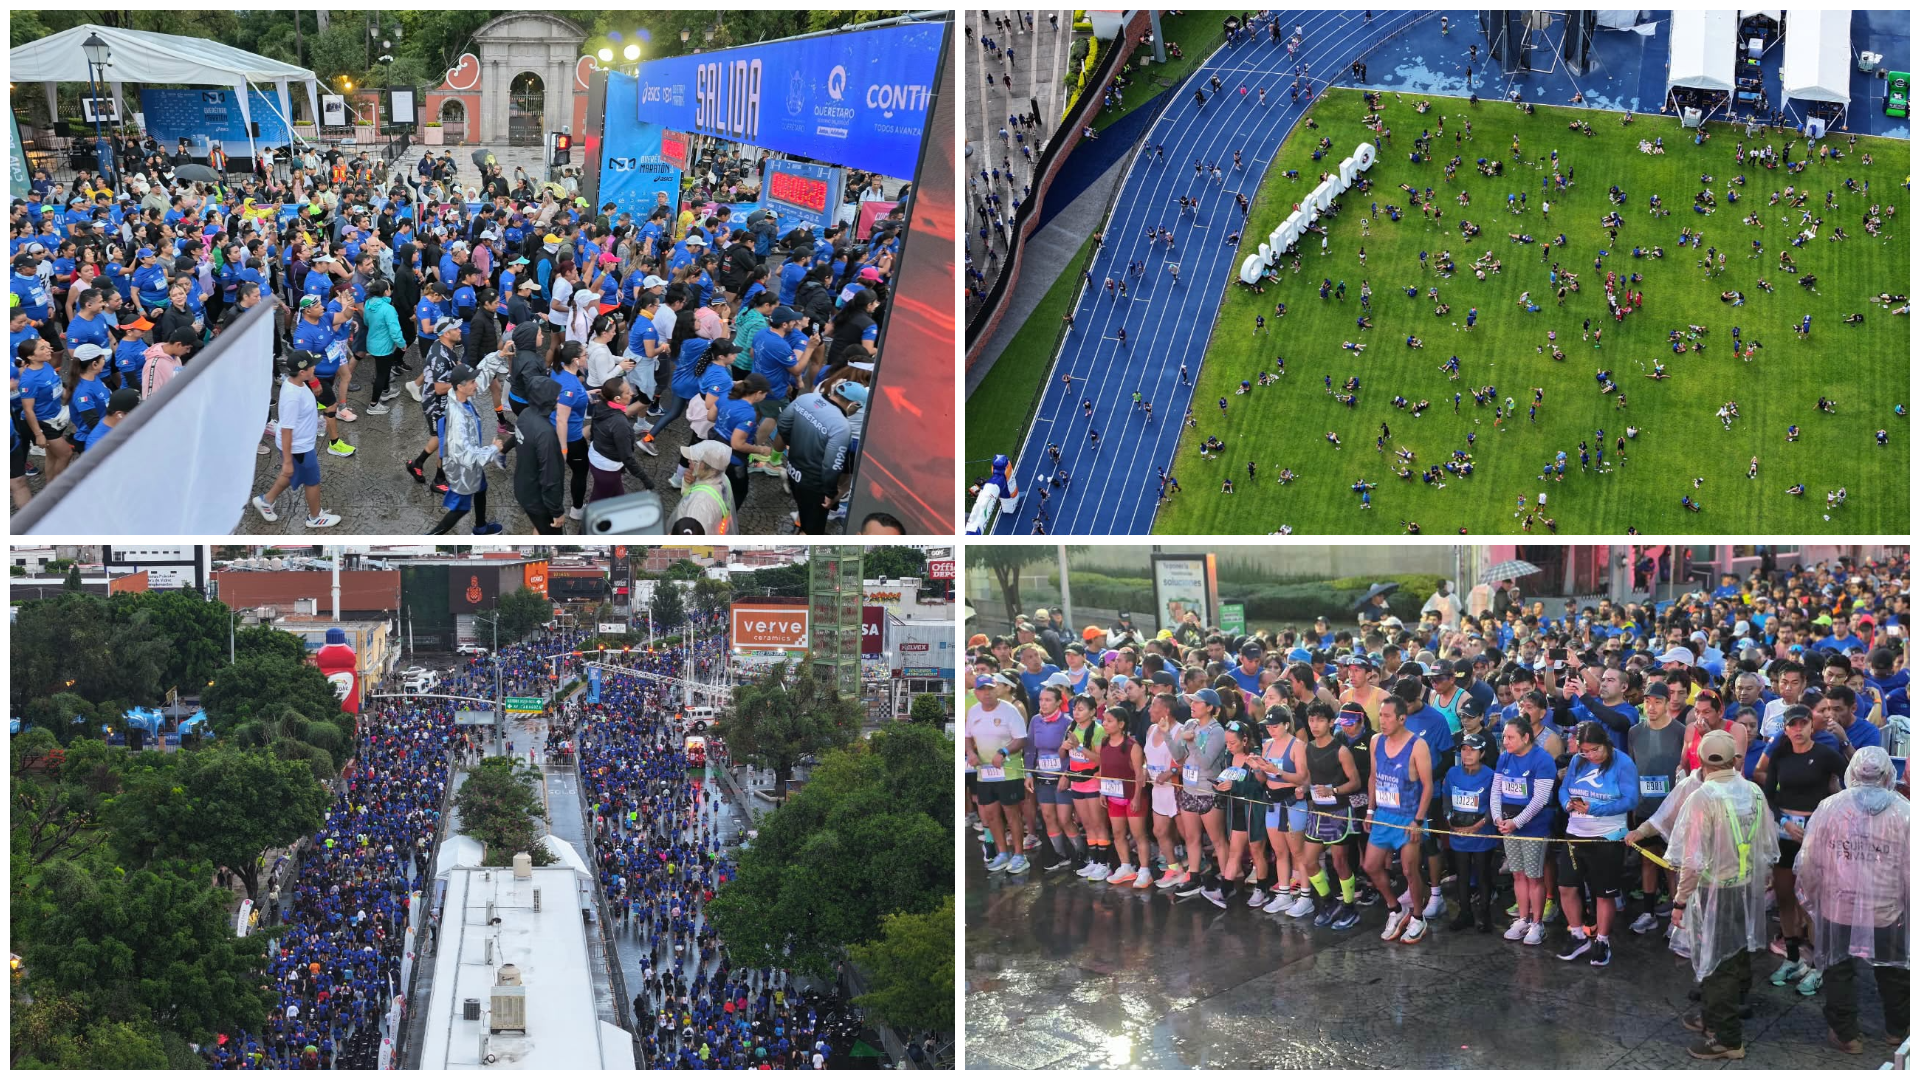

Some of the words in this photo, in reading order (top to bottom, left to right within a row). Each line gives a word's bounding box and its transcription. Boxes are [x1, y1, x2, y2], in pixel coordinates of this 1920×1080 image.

[696, 58, 762, 137] SALIDA
[866, 84, 932, 111] CONTI
[874, 123, 894, 133] TODOS
[895, 125, 923, 137] AVANZA
[640, 163, 671, 174] MARATÓN
[832, 445, 848, 471] 2020
[1163, 578, 1202, 587] soluciones
[743, 620, 802, 633] verve
[753, 634, 791, 642] ceramics
